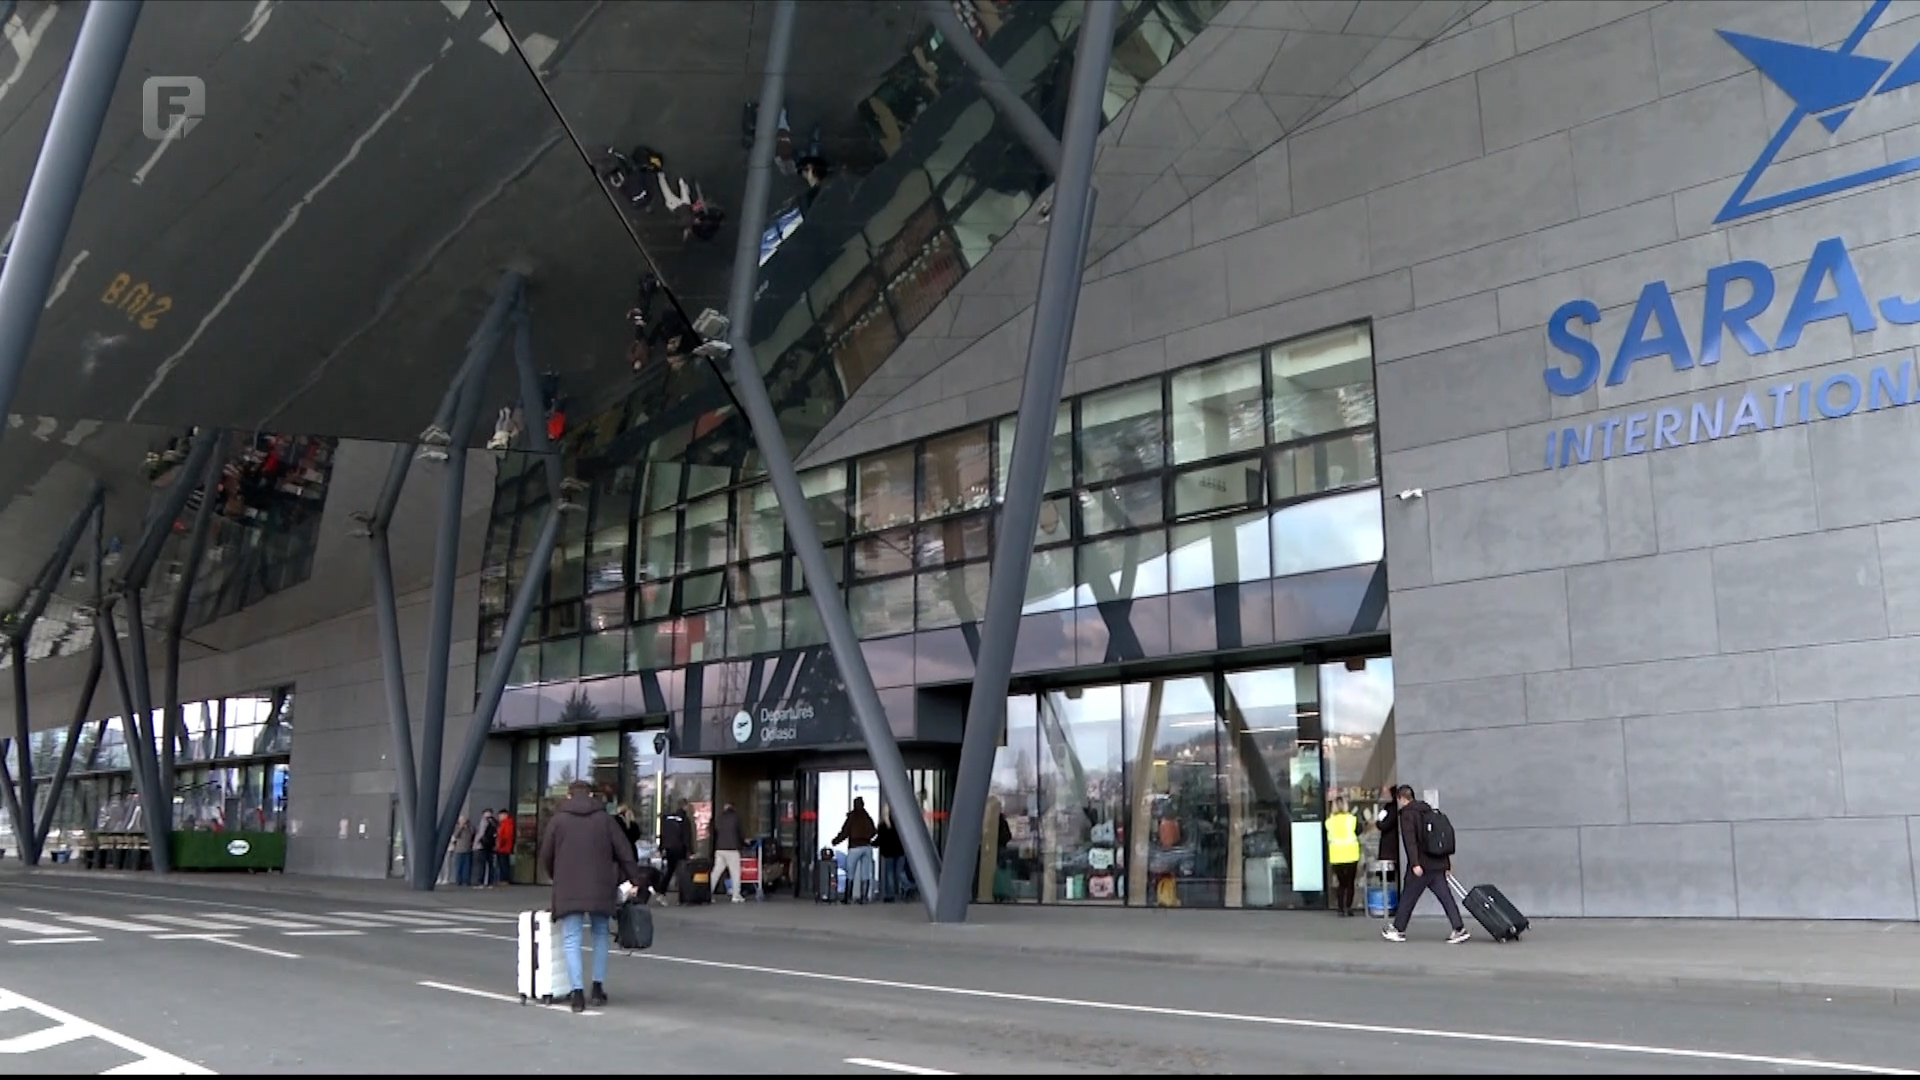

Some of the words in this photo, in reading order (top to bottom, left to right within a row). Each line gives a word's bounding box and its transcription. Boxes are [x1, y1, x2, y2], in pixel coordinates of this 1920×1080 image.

[1545, 359, 1920, 469] INTERNATION
[760, 705, 815, 725] Departures
[760, 723, 797, 742] Odlasci
